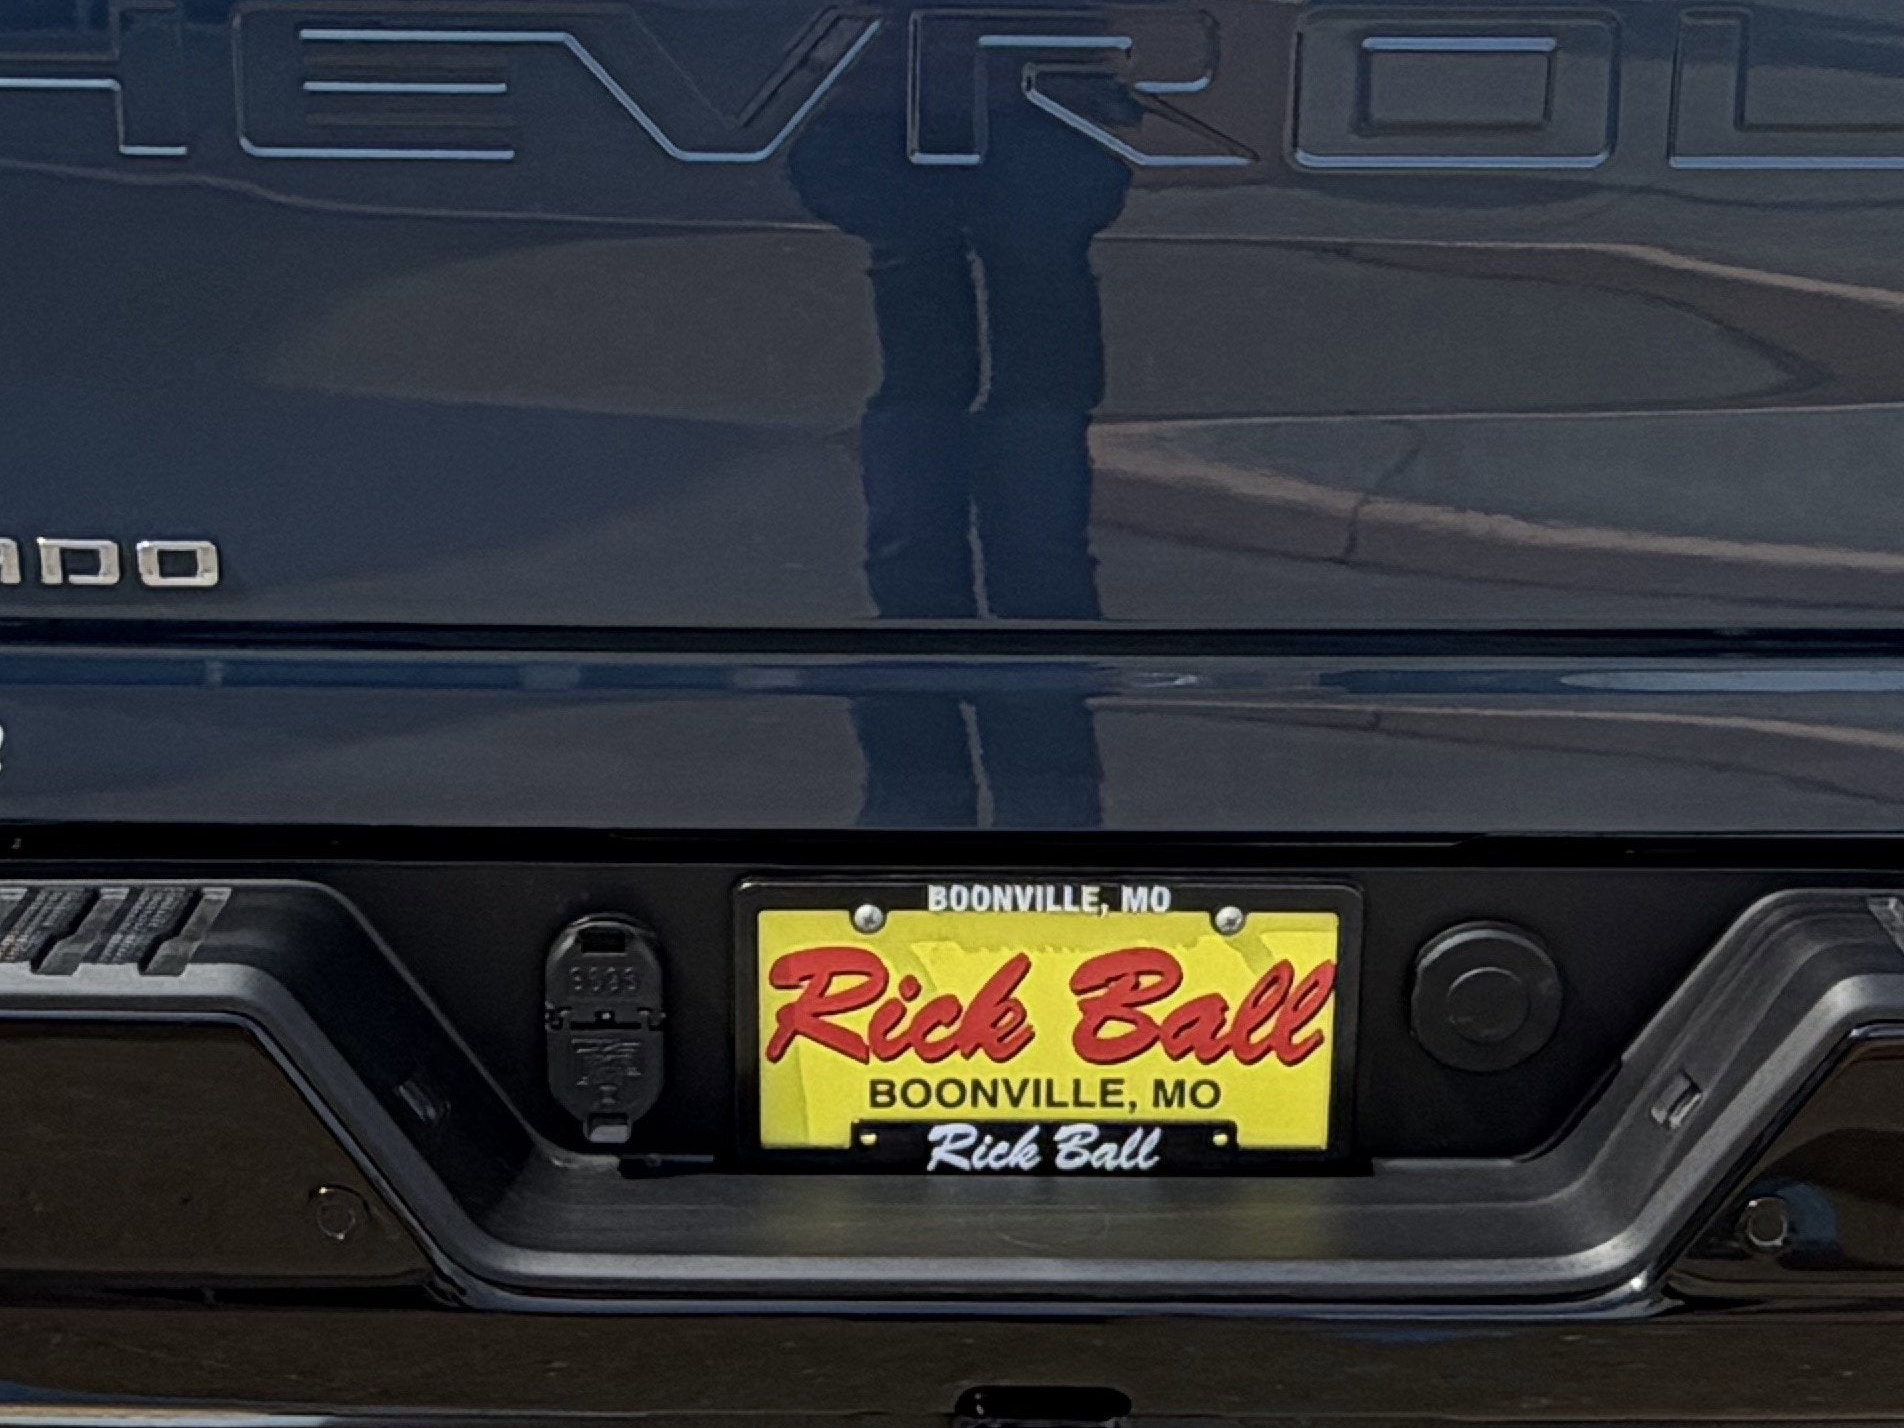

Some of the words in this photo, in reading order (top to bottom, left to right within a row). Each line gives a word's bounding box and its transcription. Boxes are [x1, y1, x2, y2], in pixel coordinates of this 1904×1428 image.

[926, 883, 1109, 916] BOONVILLE,
[1119, 885, 1171, 914] MO
[764, 945, 1036, 1068] Rick
[1068, 946, 1336, 1068] Ball
[867, 1077, 1138, 1113] BOONVILLE,
[1150, 1078, 1222, 1110] MO
[925, 1122, 1041, 1172] Rick
[1052, 1122, 1162, 1170] Ball
